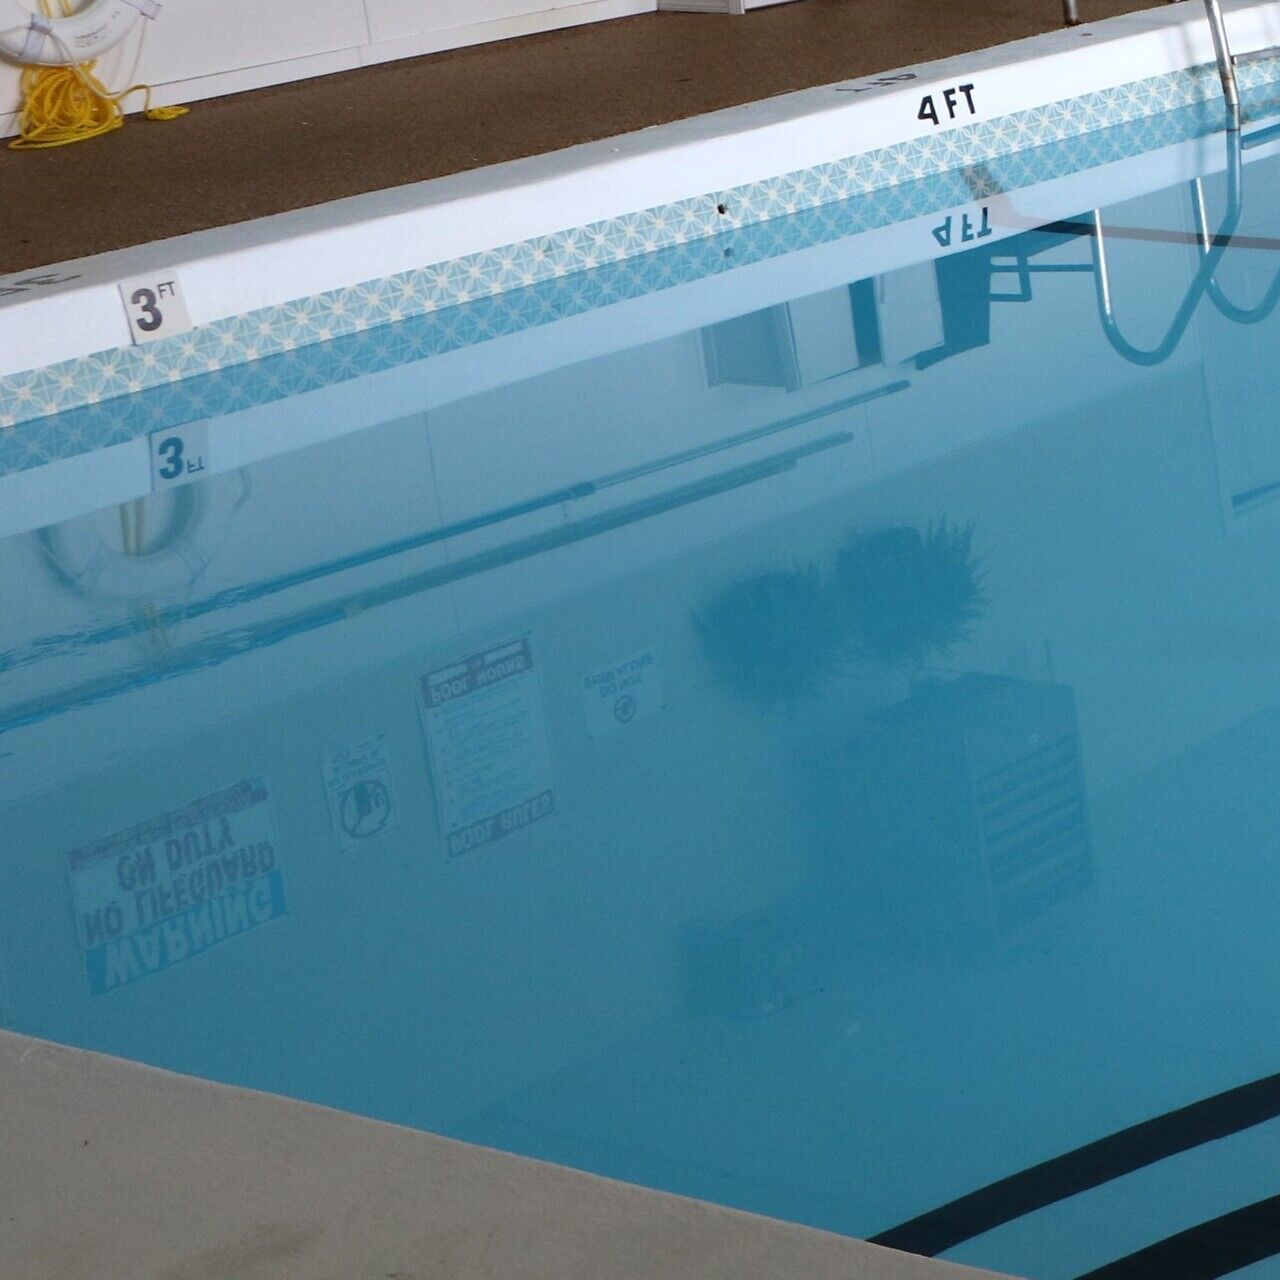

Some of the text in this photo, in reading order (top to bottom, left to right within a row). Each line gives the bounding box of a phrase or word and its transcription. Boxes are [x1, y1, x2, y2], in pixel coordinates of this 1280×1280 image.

[918, 83, 976, 126] 4 FT
[131, 288, 163, 332] 3
